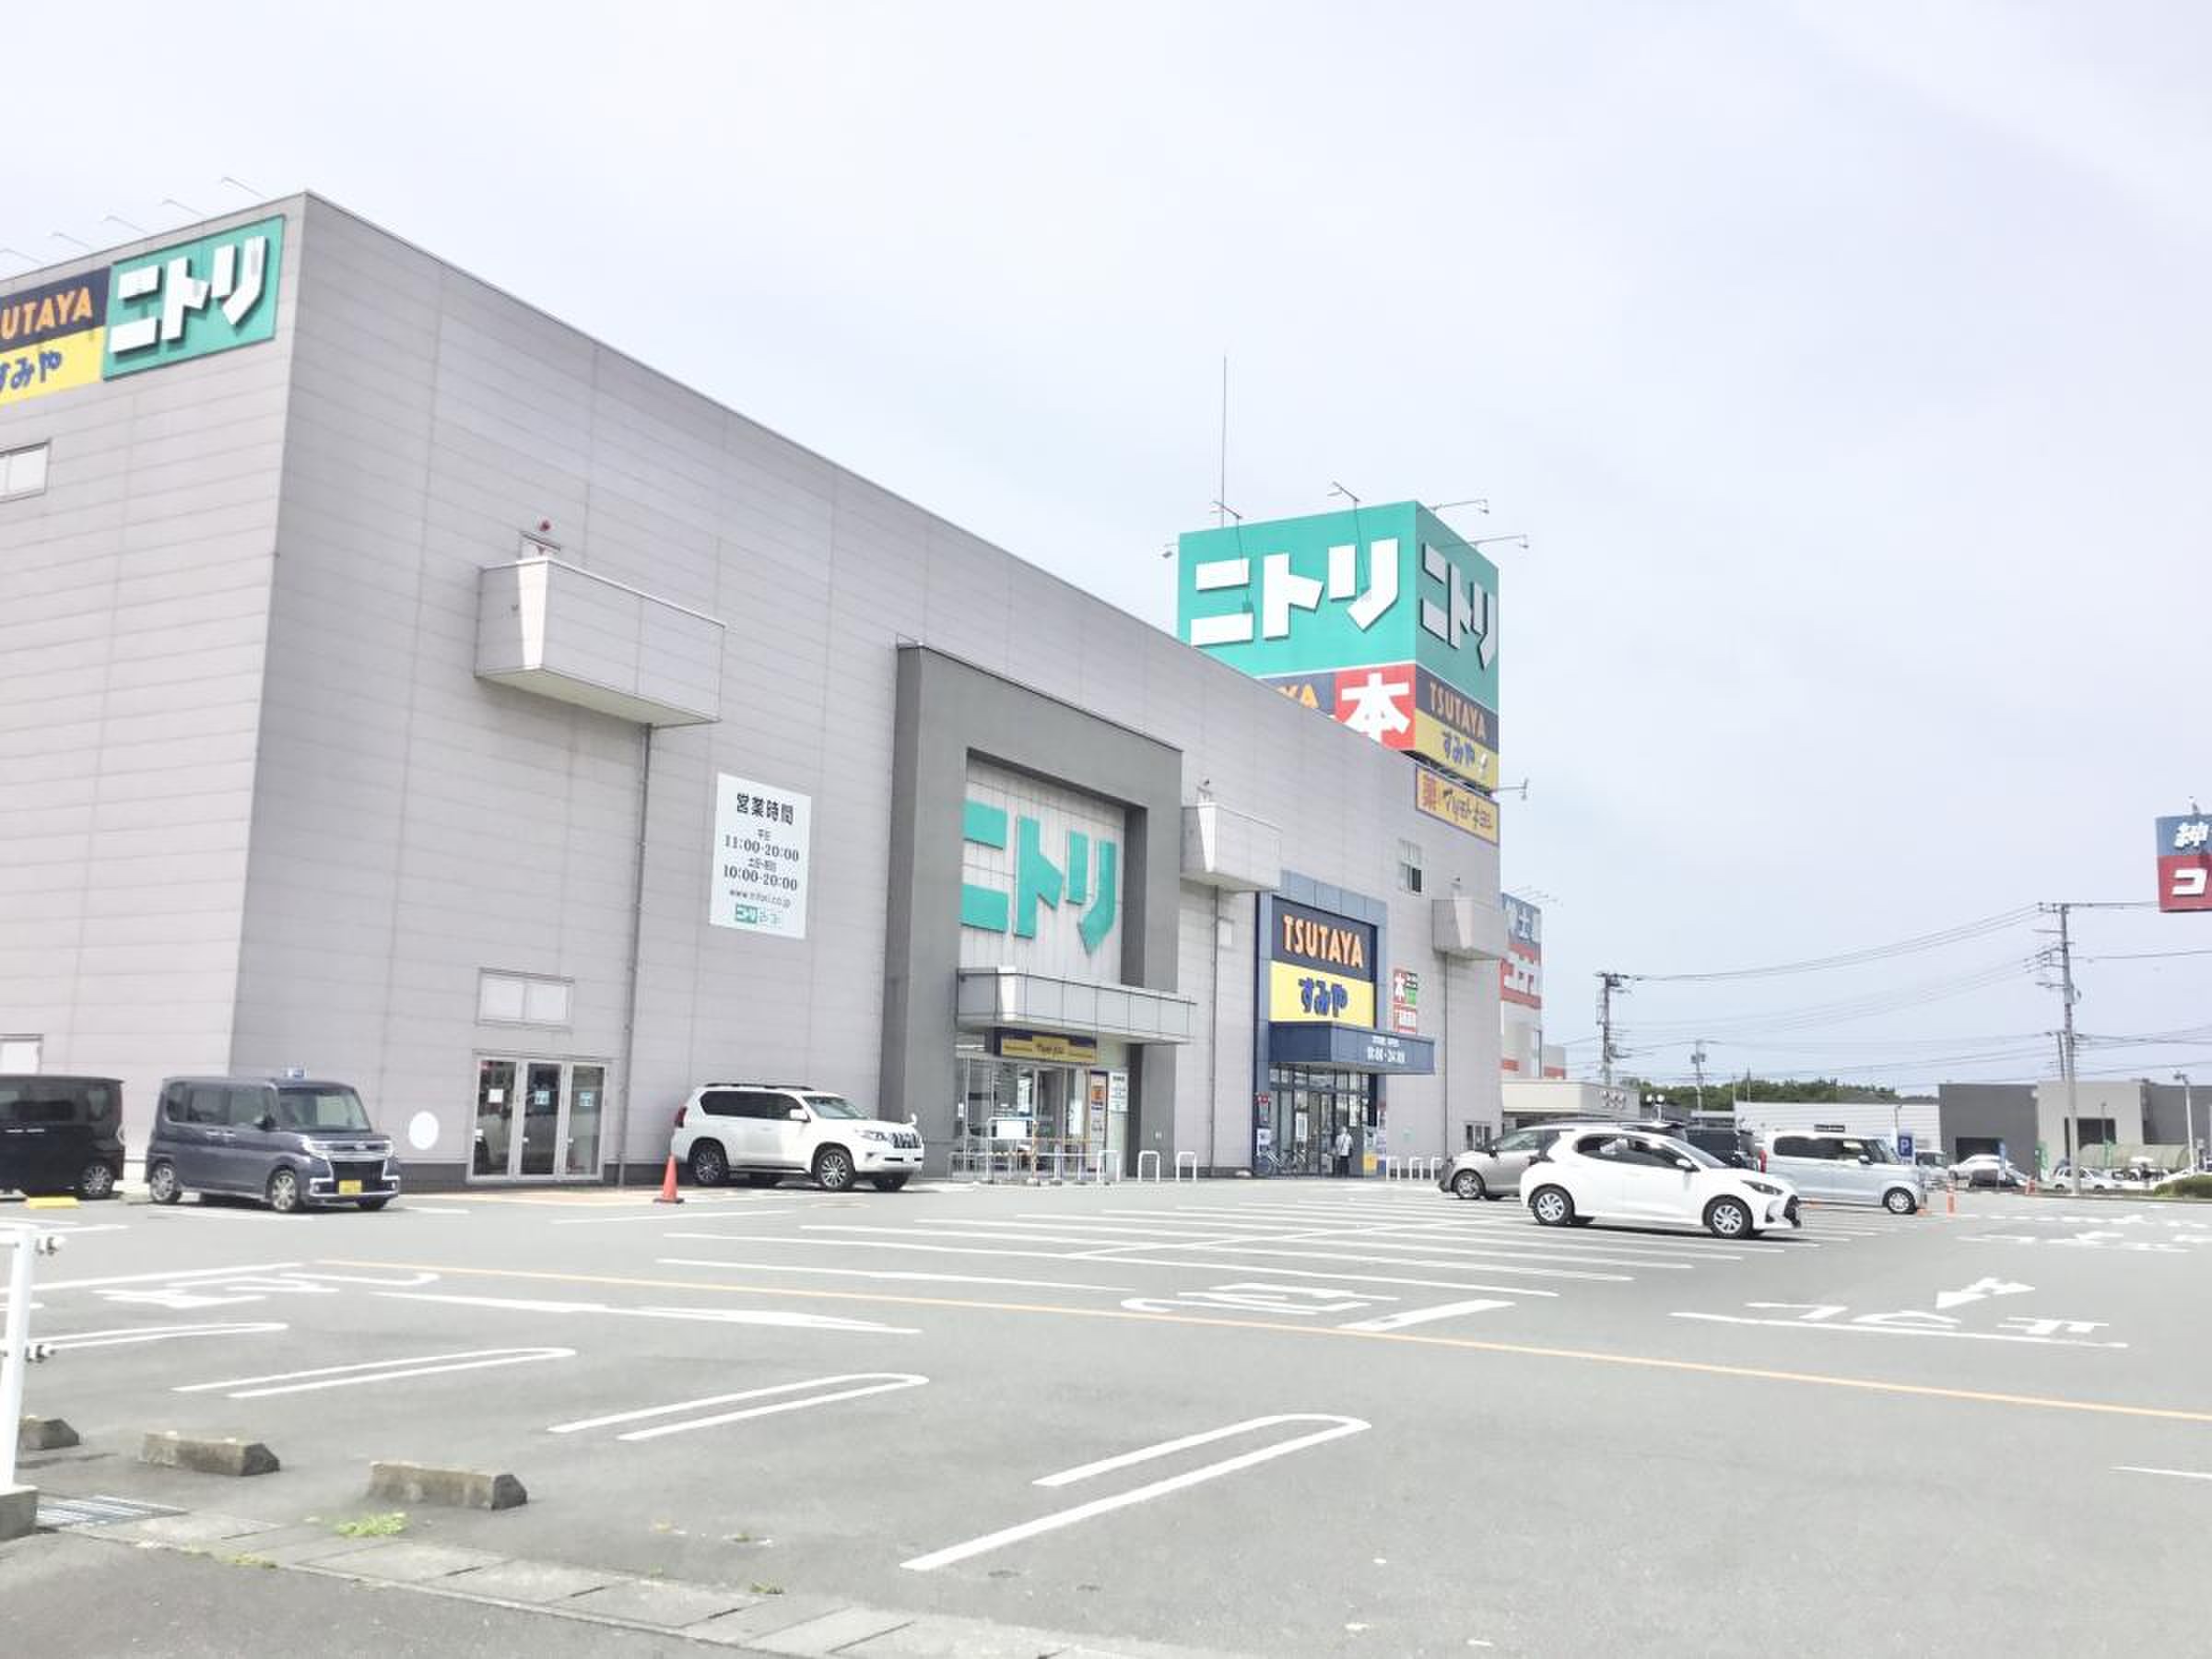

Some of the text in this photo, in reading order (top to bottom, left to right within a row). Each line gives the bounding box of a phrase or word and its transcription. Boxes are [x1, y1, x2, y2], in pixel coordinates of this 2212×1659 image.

[1, 287, 93, 340] UTAYA
[109, 235, 266, 354] ニトリ
[1190, 538, 1399, 647] ニトリ
[1420, 541, 1496, 672] ニトリ
[1341, 672, 1411, 741] 本
[1430, 680, 1487, 740] TSUTAYA
[736, 793, 794, 826] 営業時間
[959, 798, 1117, 957] ニトリ
[2172, 867, 2208, 896] コ
[1282, 914, 1364, 968] TSUTAYA
[1298, 977, 1348, 1018] すみや
[1900, 1138, 1910, 1154] P
